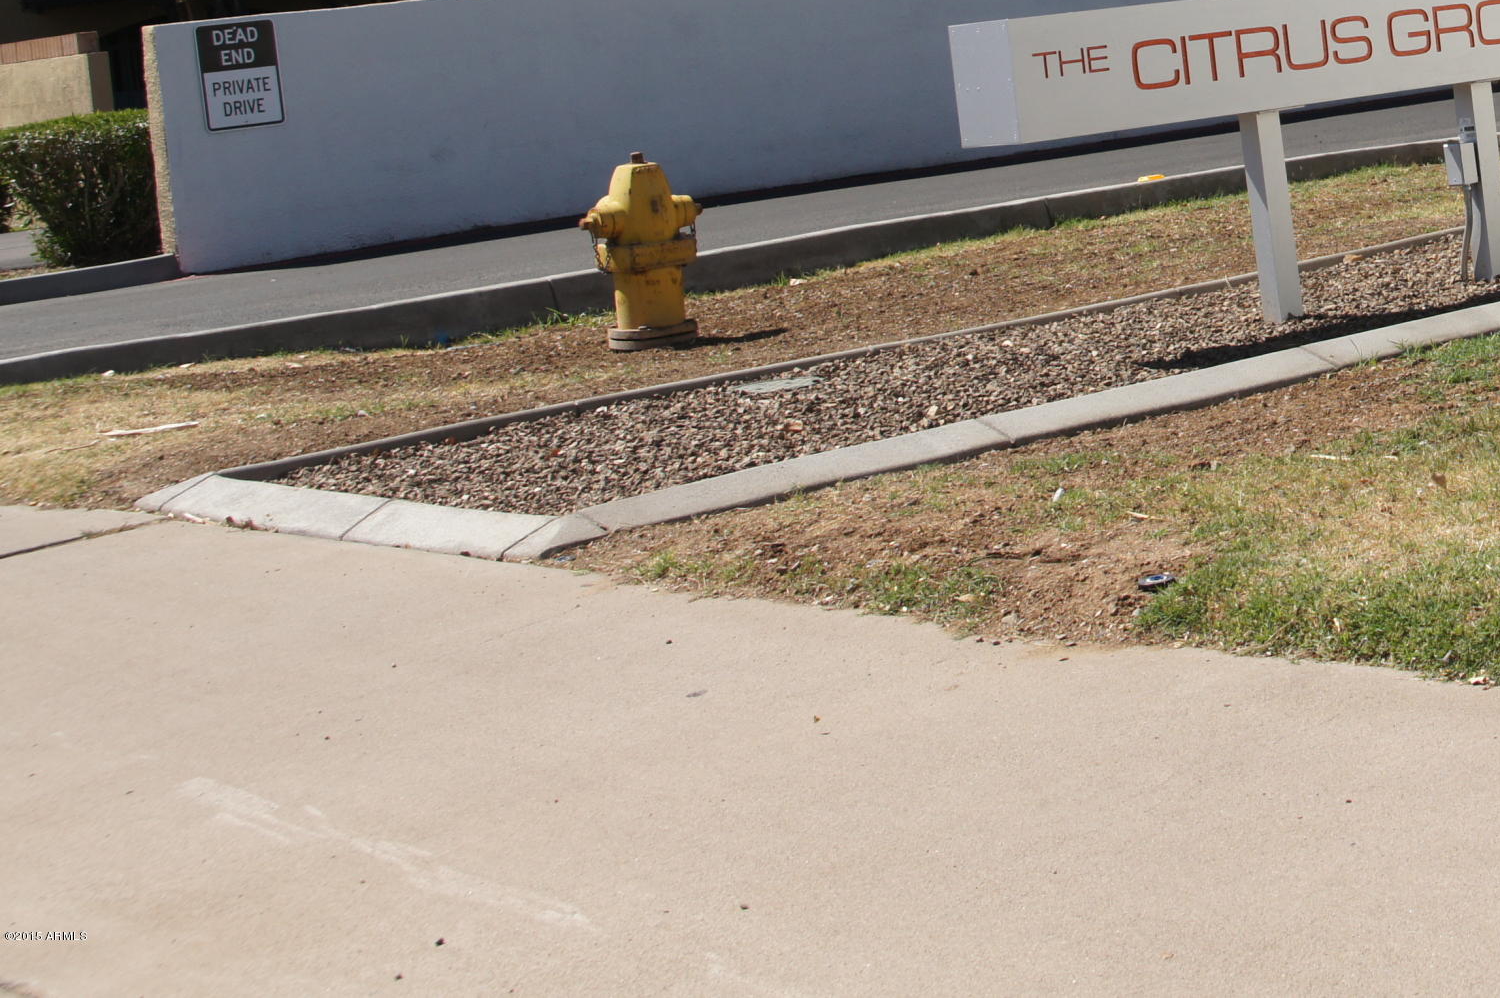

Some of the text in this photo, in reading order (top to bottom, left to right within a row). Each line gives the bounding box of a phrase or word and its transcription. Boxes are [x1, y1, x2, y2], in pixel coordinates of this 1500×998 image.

[212, 26, 259, 46] DEAD
[221, 48, 256, 66] END
[1032, 45, 1110, 79] THE
[1131, 15, 1373, 90] CITRUS
[212, 76, 272, 97] PRIVATE
[223, 98, 266, 116] DRIVE
